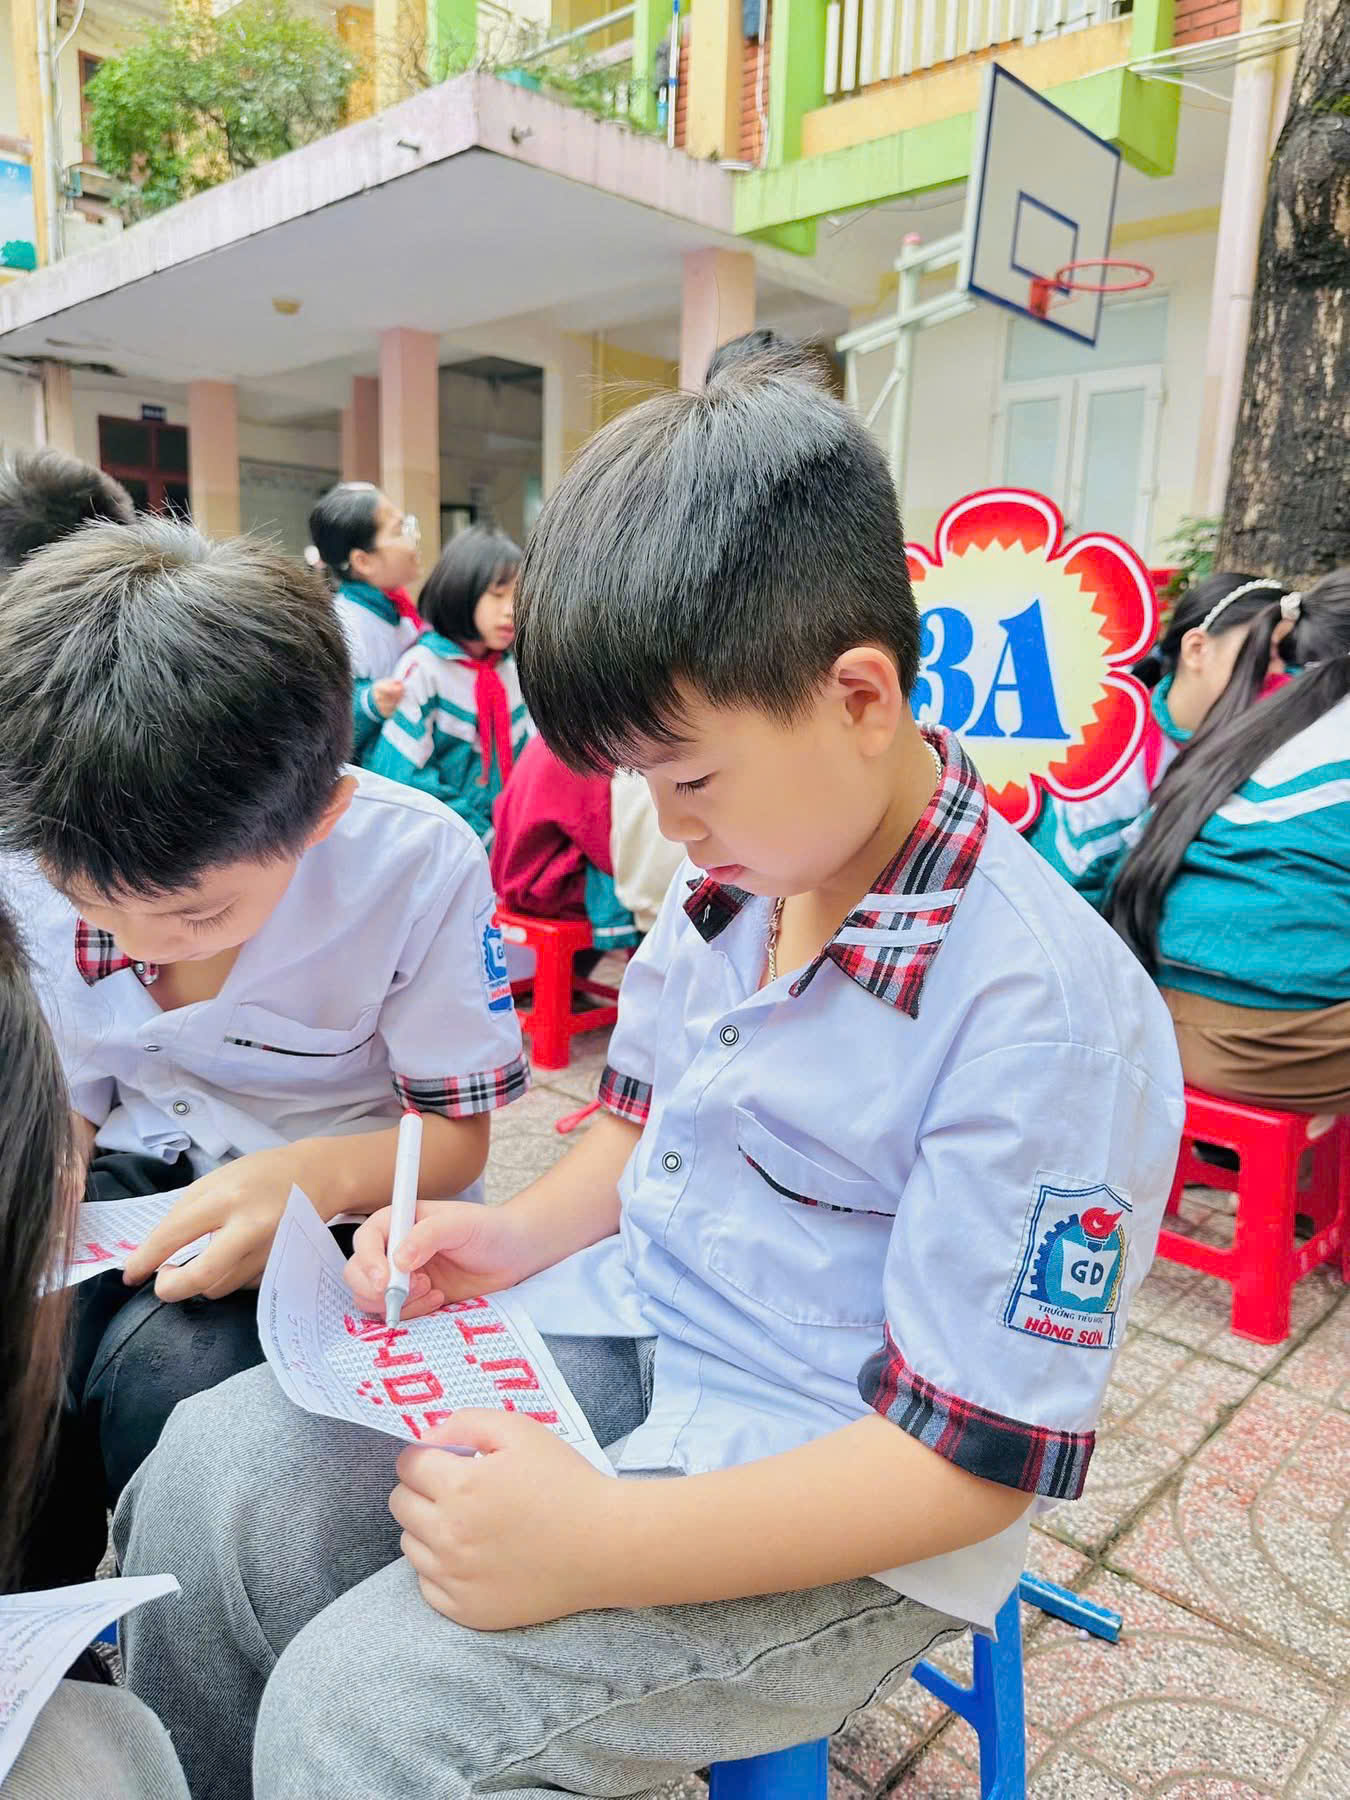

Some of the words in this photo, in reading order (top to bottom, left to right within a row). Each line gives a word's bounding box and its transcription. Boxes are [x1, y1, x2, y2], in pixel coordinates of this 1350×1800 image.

[910, 599, 1071, 740] 3A
[1071, 1260, 1104, 1285] GD
[1038, 1303, 1076, 1321] TRƯỜNG
[1024, 1314, 1074, 1340] HỒNG
[1077, 1329, 1103, 1345] SƠN
